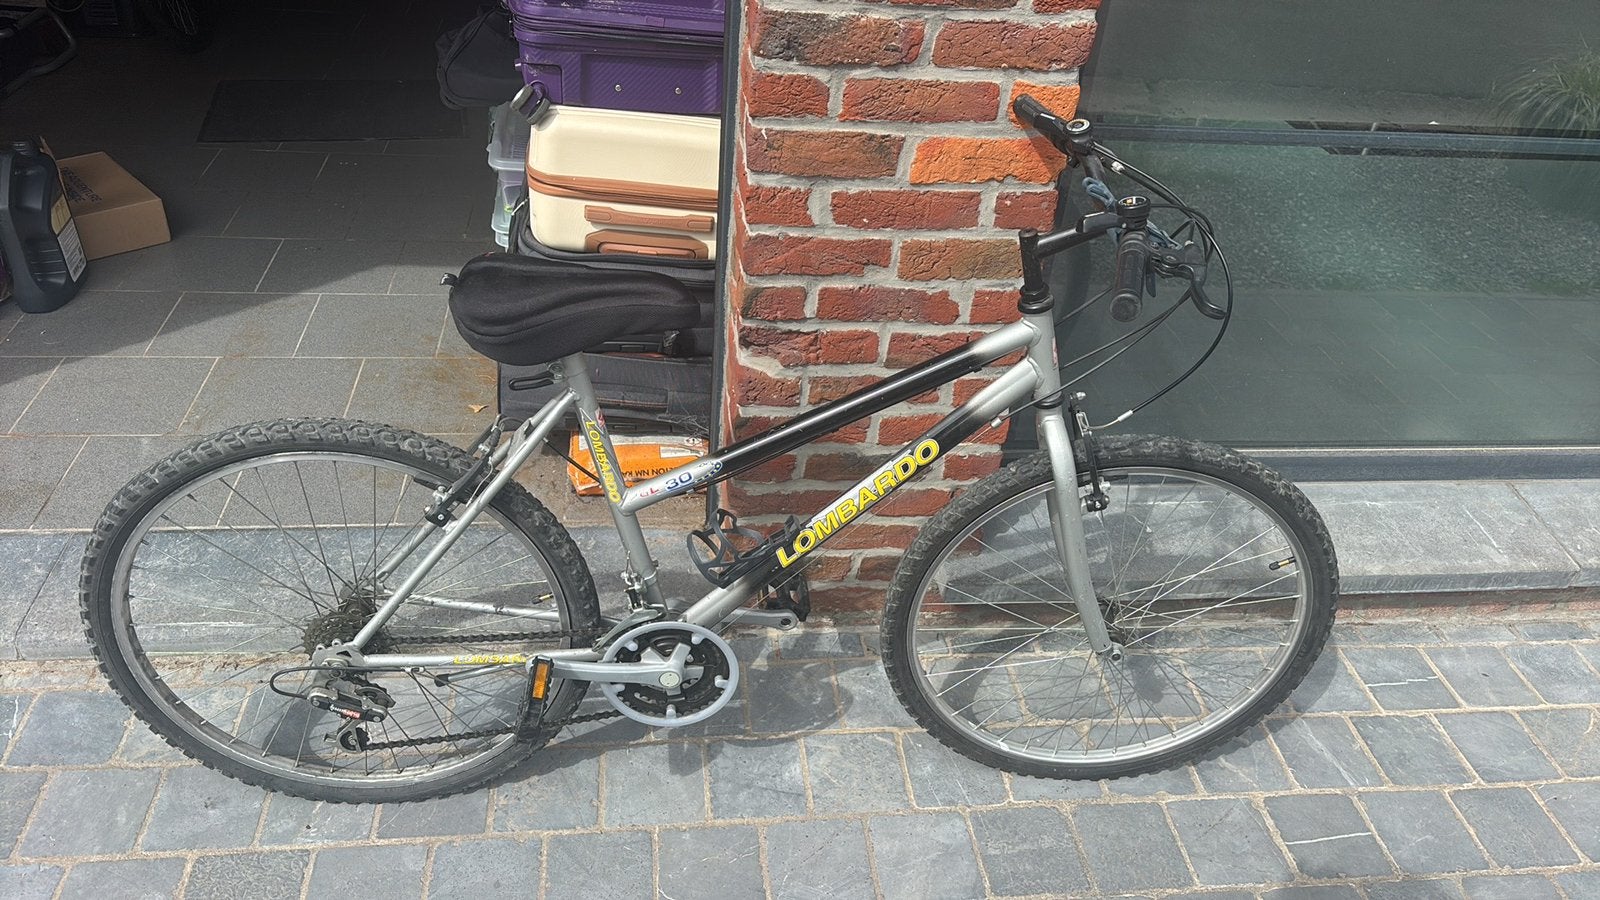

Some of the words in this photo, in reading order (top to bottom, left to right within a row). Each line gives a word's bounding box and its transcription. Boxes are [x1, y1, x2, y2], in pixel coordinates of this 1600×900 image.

[585, 420, 621, 504] LOMBARDO
[665, 471, 694, 492] 30
[775, 438, 940, 568] LOMBARDO
